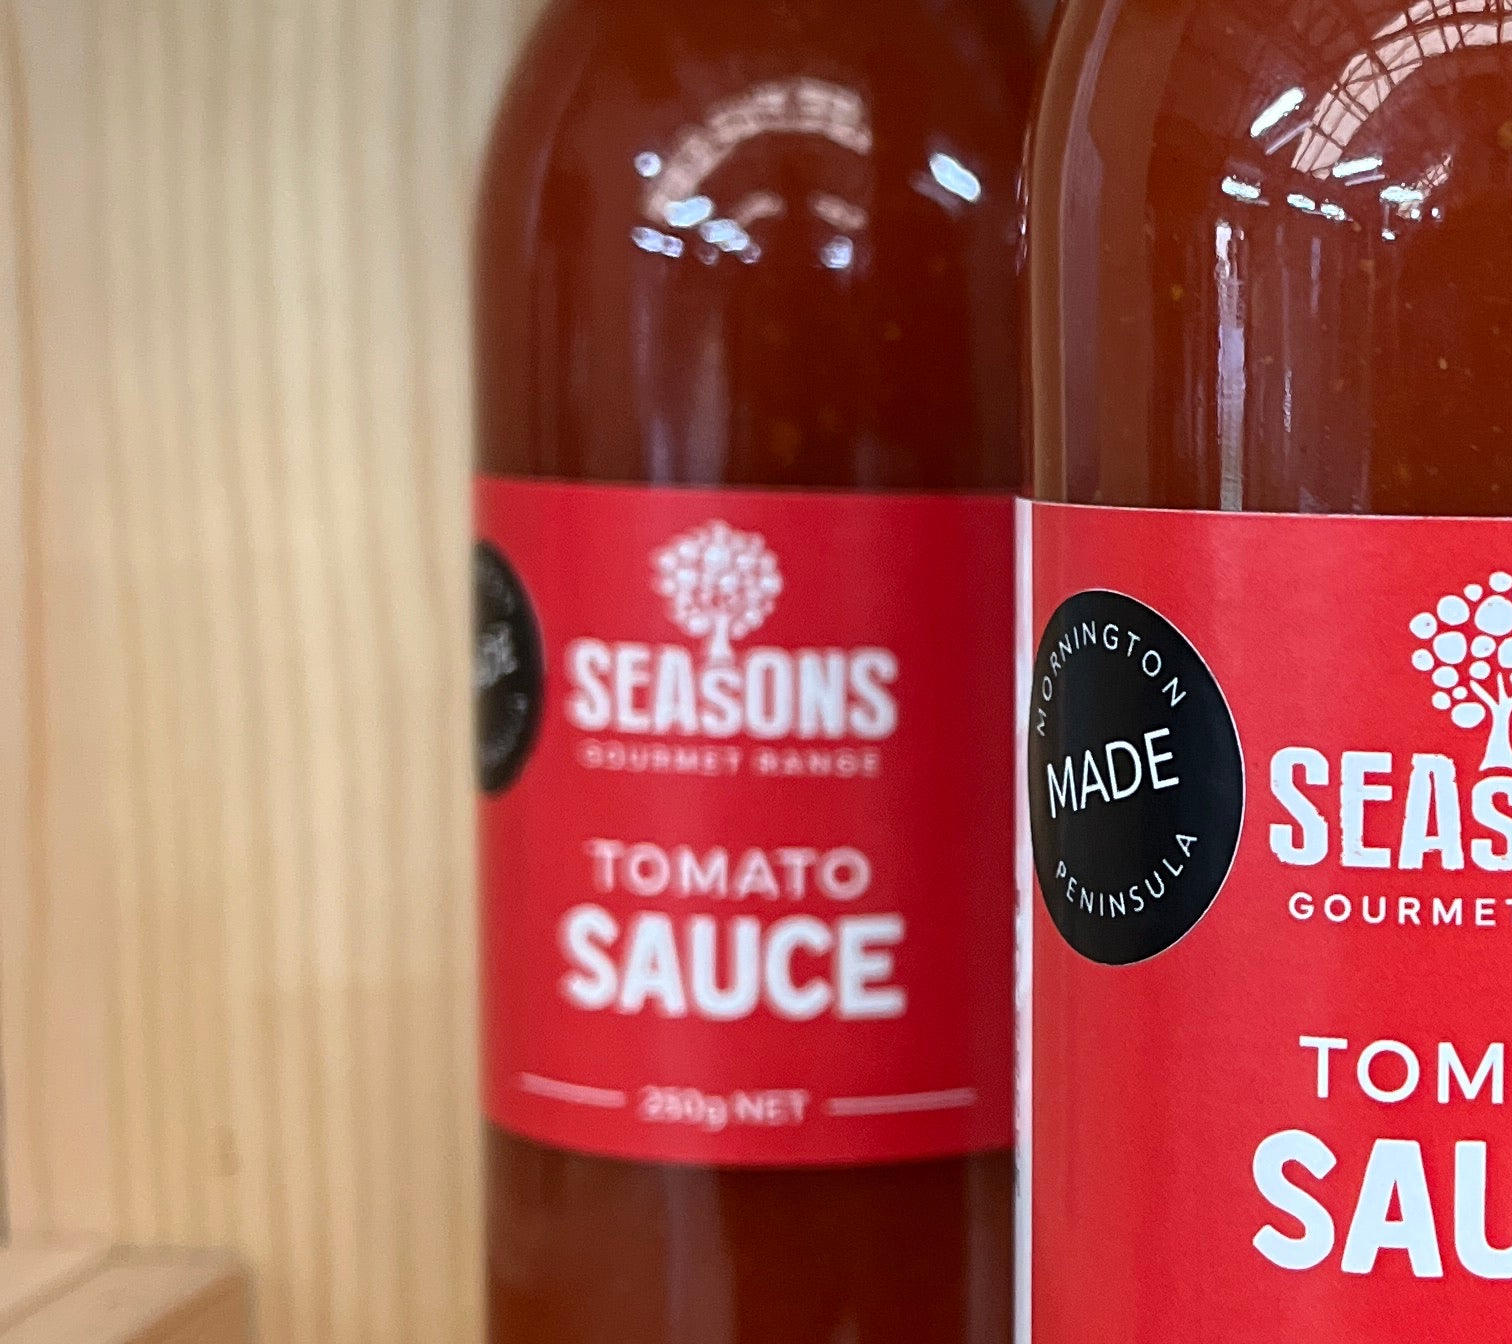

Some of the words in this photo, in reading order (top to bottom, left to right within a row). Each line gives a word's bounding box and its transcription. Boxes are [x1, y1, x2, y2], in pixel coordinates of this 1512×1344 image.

[574, 637, 898, 740] SEASONS
[1036, 620, 1186, 736] MORNINGTON
[584, 737, 740, 775] GOURMET
[756, 744, 881, 778] RANGE
[1047, 727, 1180, 819] MADE
[592, 839, 872, 900] TOMATO
[1055, 832, 1198, 918] PENINSULA
[563, 905, 906, 1019] SAUCE
[736, 1089, 810, 1125] NET
